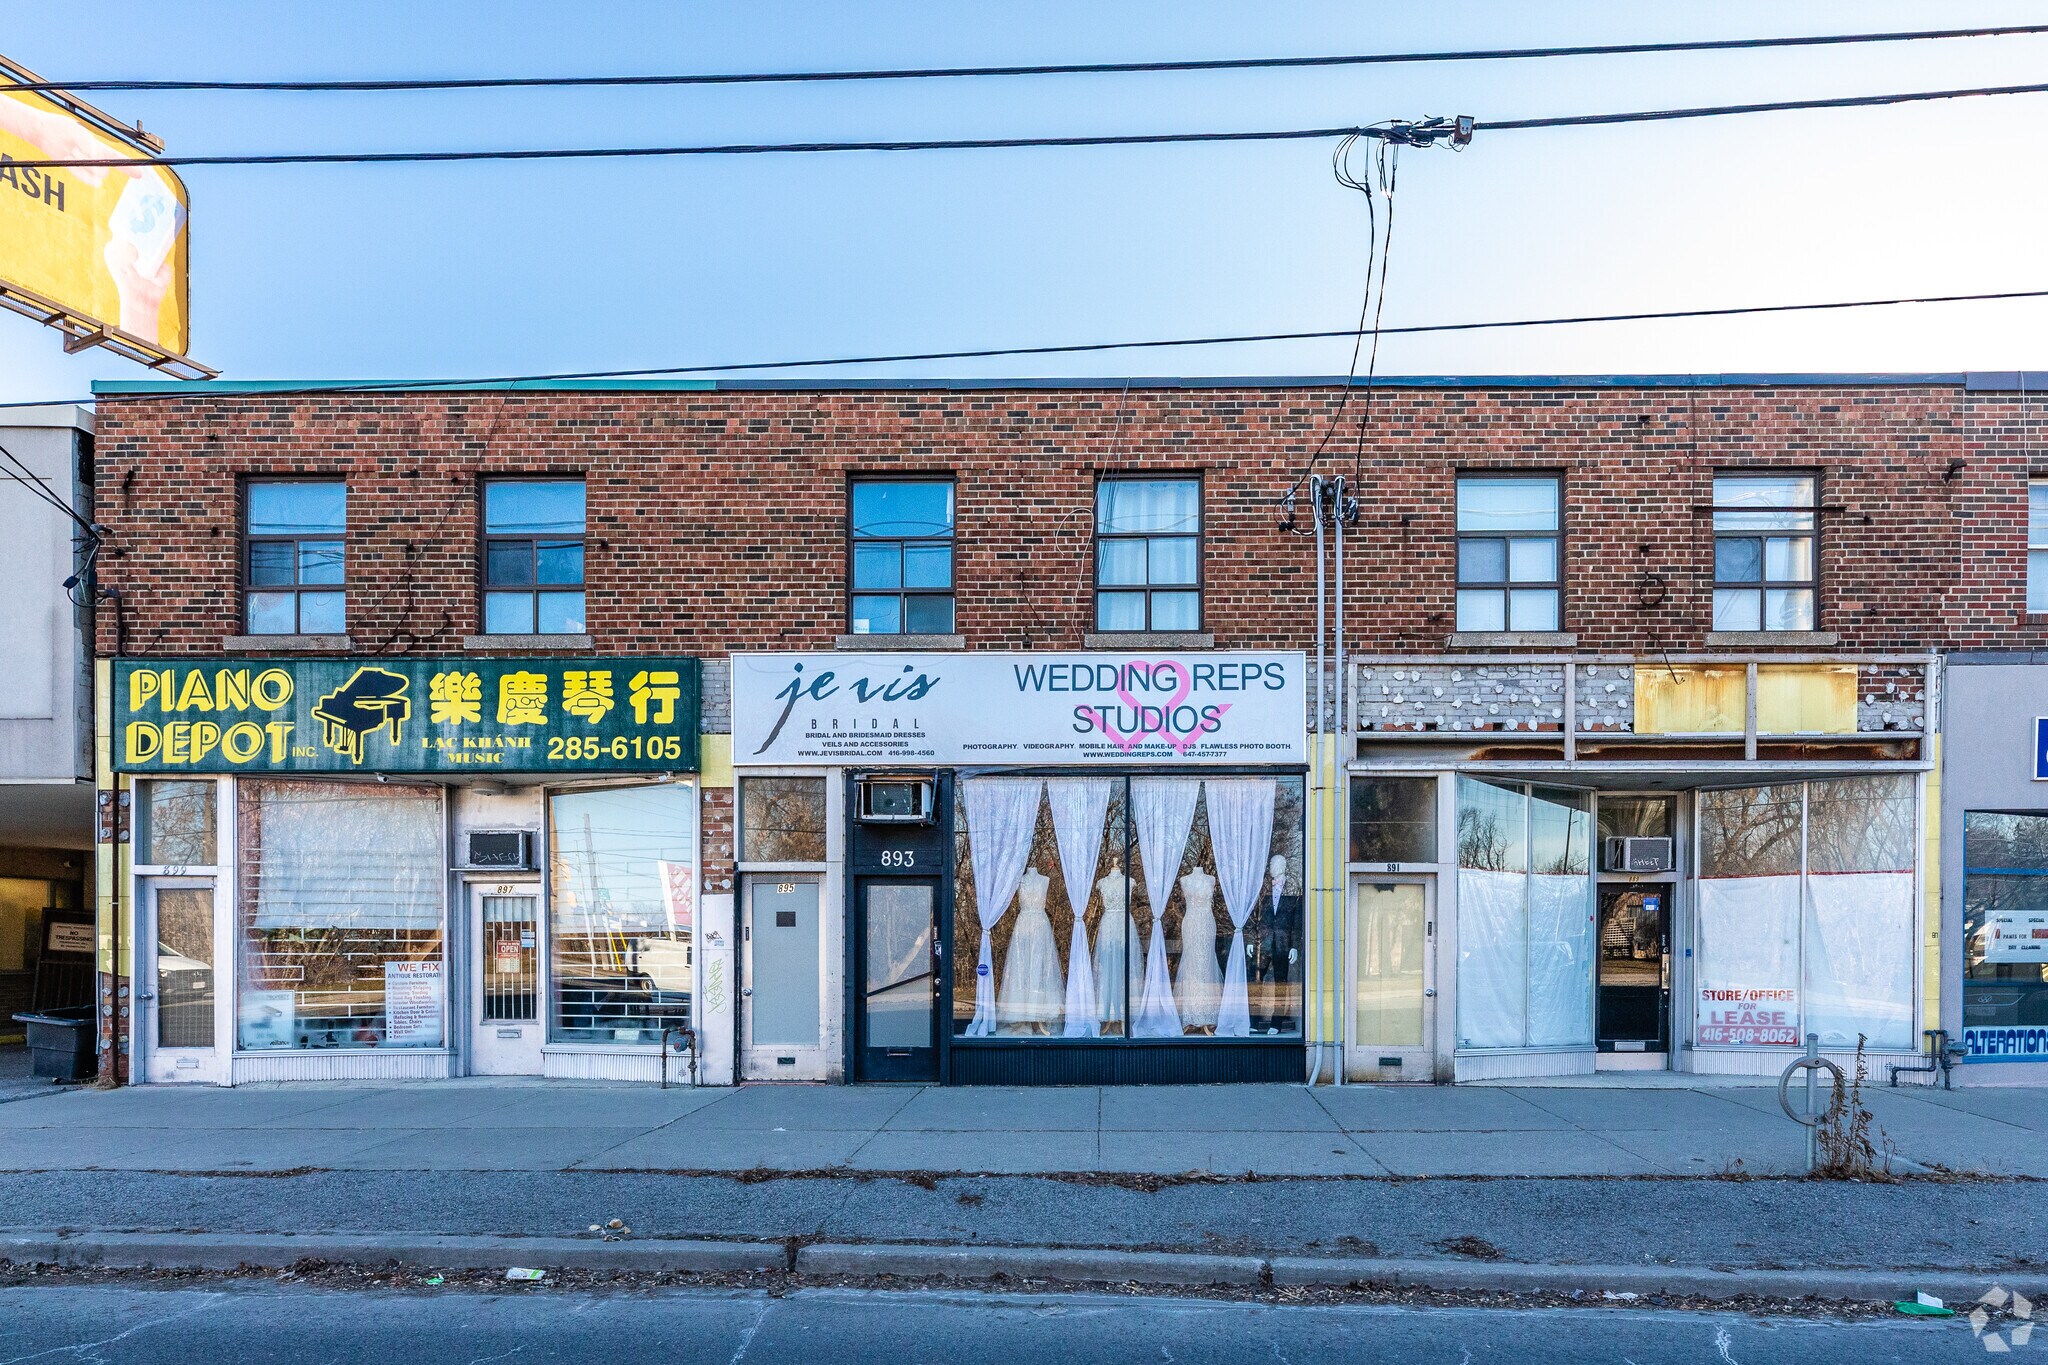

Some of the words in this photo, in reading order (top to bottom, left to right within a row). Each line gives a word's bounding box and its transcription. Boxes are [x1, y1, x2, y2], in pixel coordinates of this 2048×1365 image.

[1013, 663, 1178, 692] WEDDING
[1193, 662, 1286, 691] REPS
[129, 667, 295, 712] PIANO
[429, 670, 681, 725] 樂慶琴行
[811, 718, 920, 730] BRIDAL
[1072, 704, 1222, 734] STUDIOS
[125, 721, 295, 764] DEPOT
[292, 746, 319, 757] INC.
[547, 736, 681, 760] 285-6105
[447, 752, 504, 764] MUSIC
[881, 850, 915, 867] 893
[163, 865, 187, 876] 899
[1386, 863, 1400, 872] 891
[497, 885, 514, 894] 897
[777, 884, 795, 893] 895
[501, 945, 519, 953] OPEN
[397, 963, 416, 971] WE
[422, 963, 440, 971] FIX
[1702, 989, 1794, 1001] STORE/OFFICE
[1738, 1002, 1757, 1010] FOR
[1710, 1011, 1786, 1025] LEASE
[1702, 1028, 1795, 1042] 416-508-8062
[1965, 1029, 2048, 1054] ALTERATION
